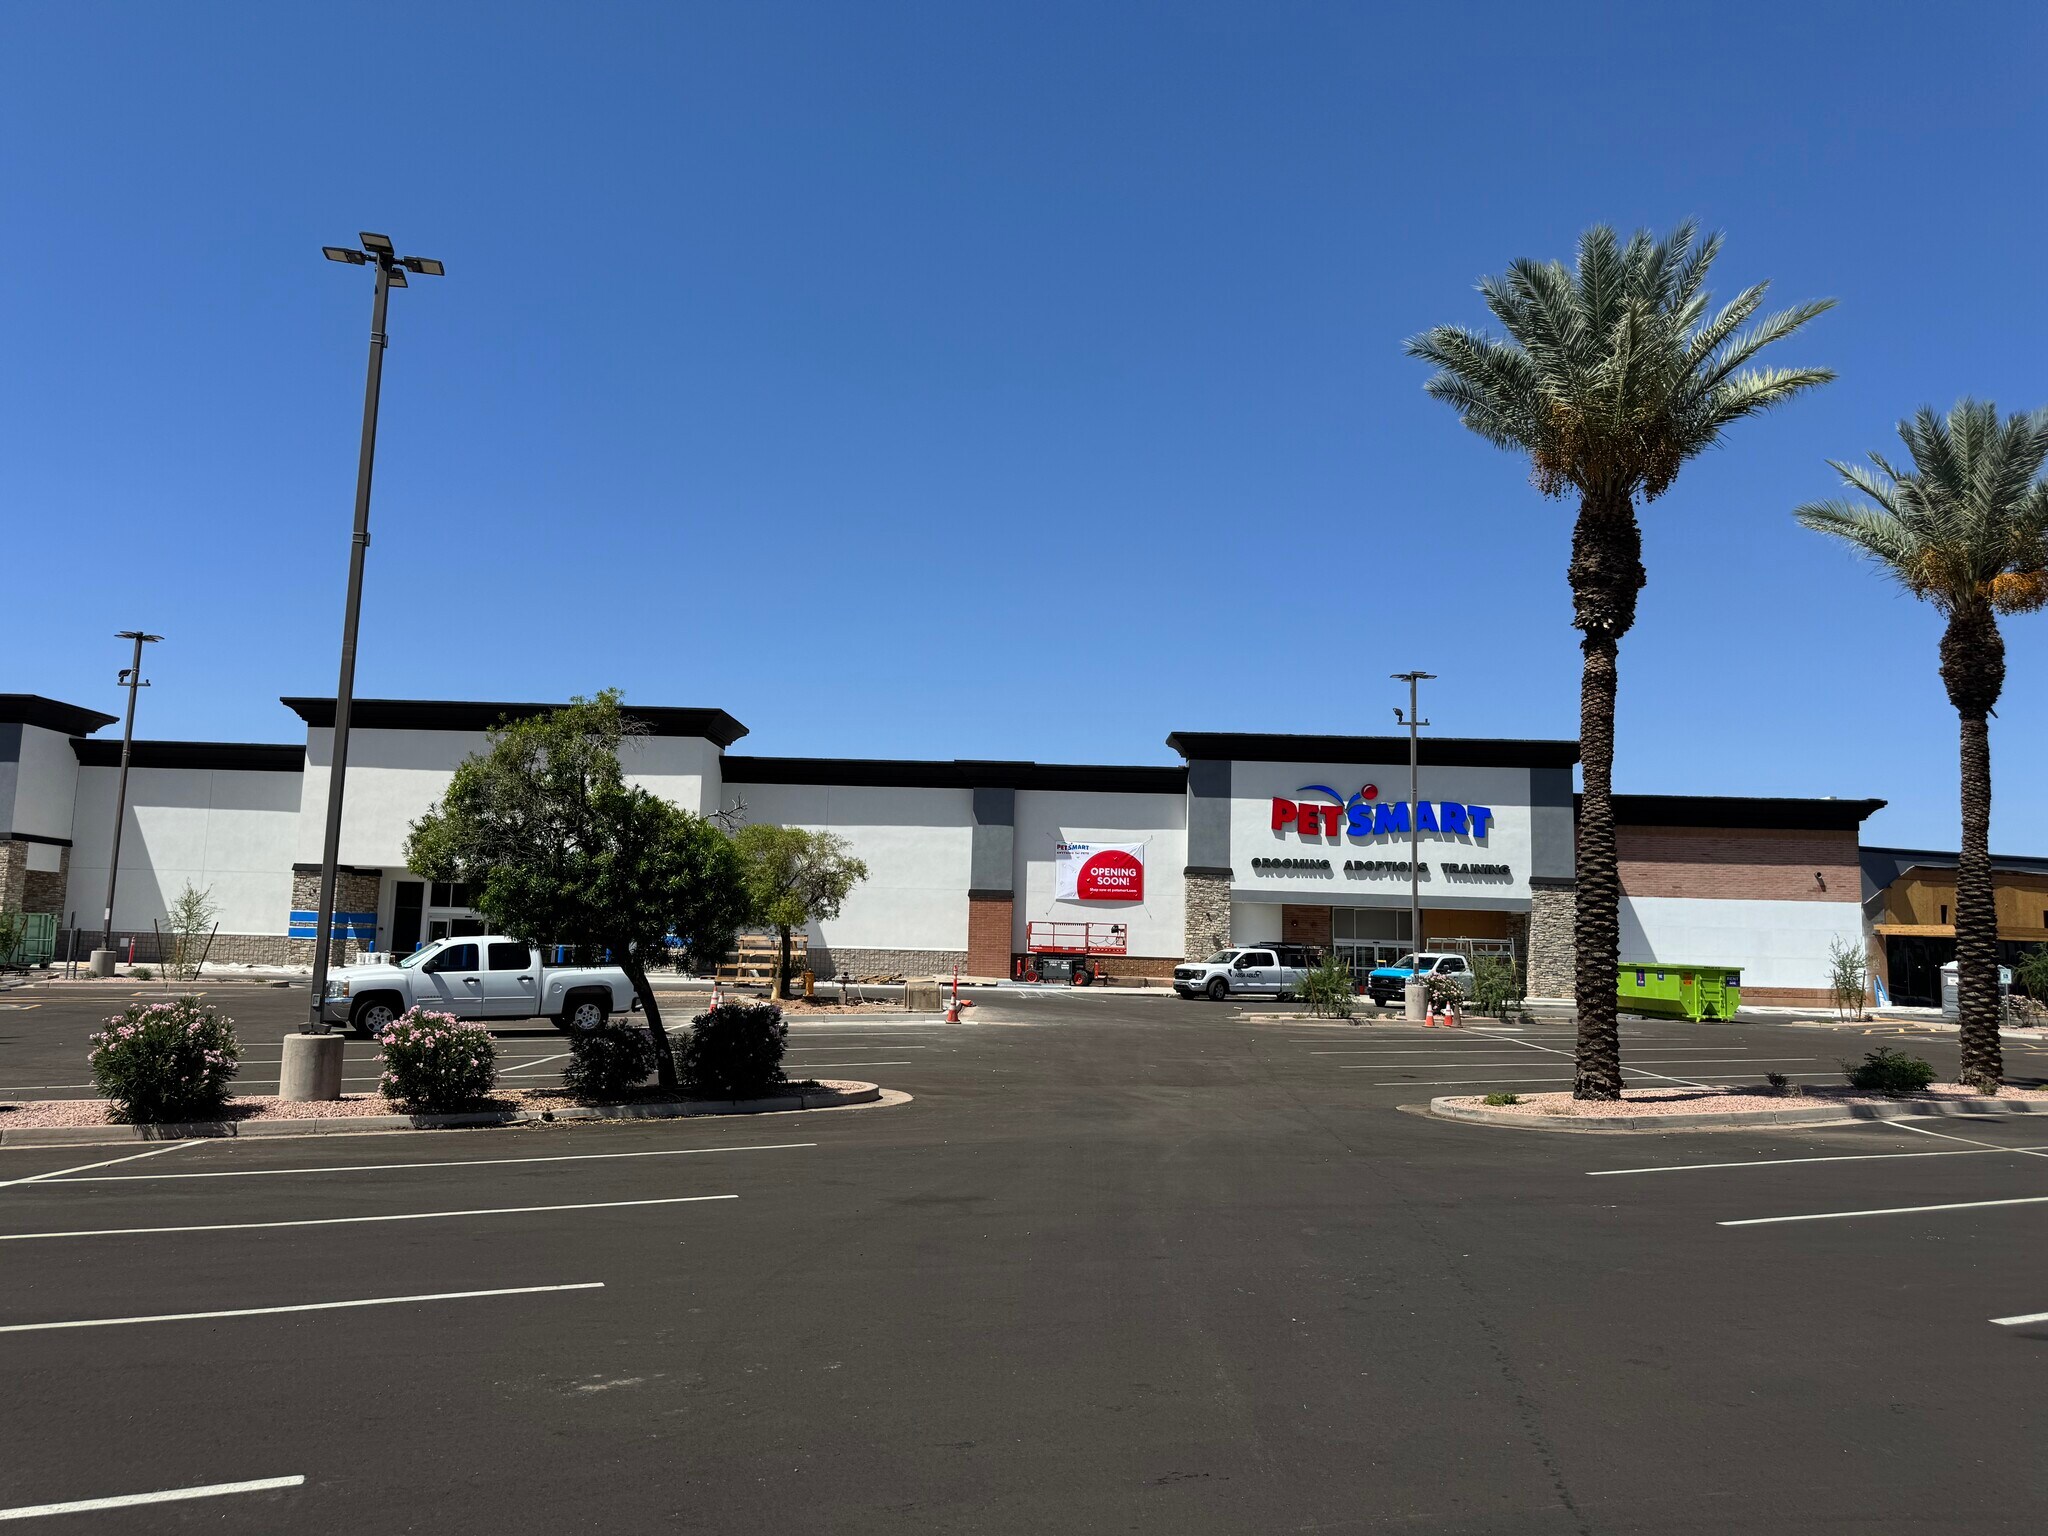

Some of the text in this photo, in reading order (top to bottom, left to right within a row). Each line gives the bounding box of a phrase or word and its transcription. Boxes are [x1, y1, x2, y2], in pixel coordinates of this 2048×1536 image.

[1271, 796, 1492, 839] PETSMART
[1090, 867, 1137, 877] OPENING
[1251, 857, 1330, 870] GROOMING
[1440, 863, 1511, 875] TRAINING
[1097, 876, 1130, 886] SOON!
